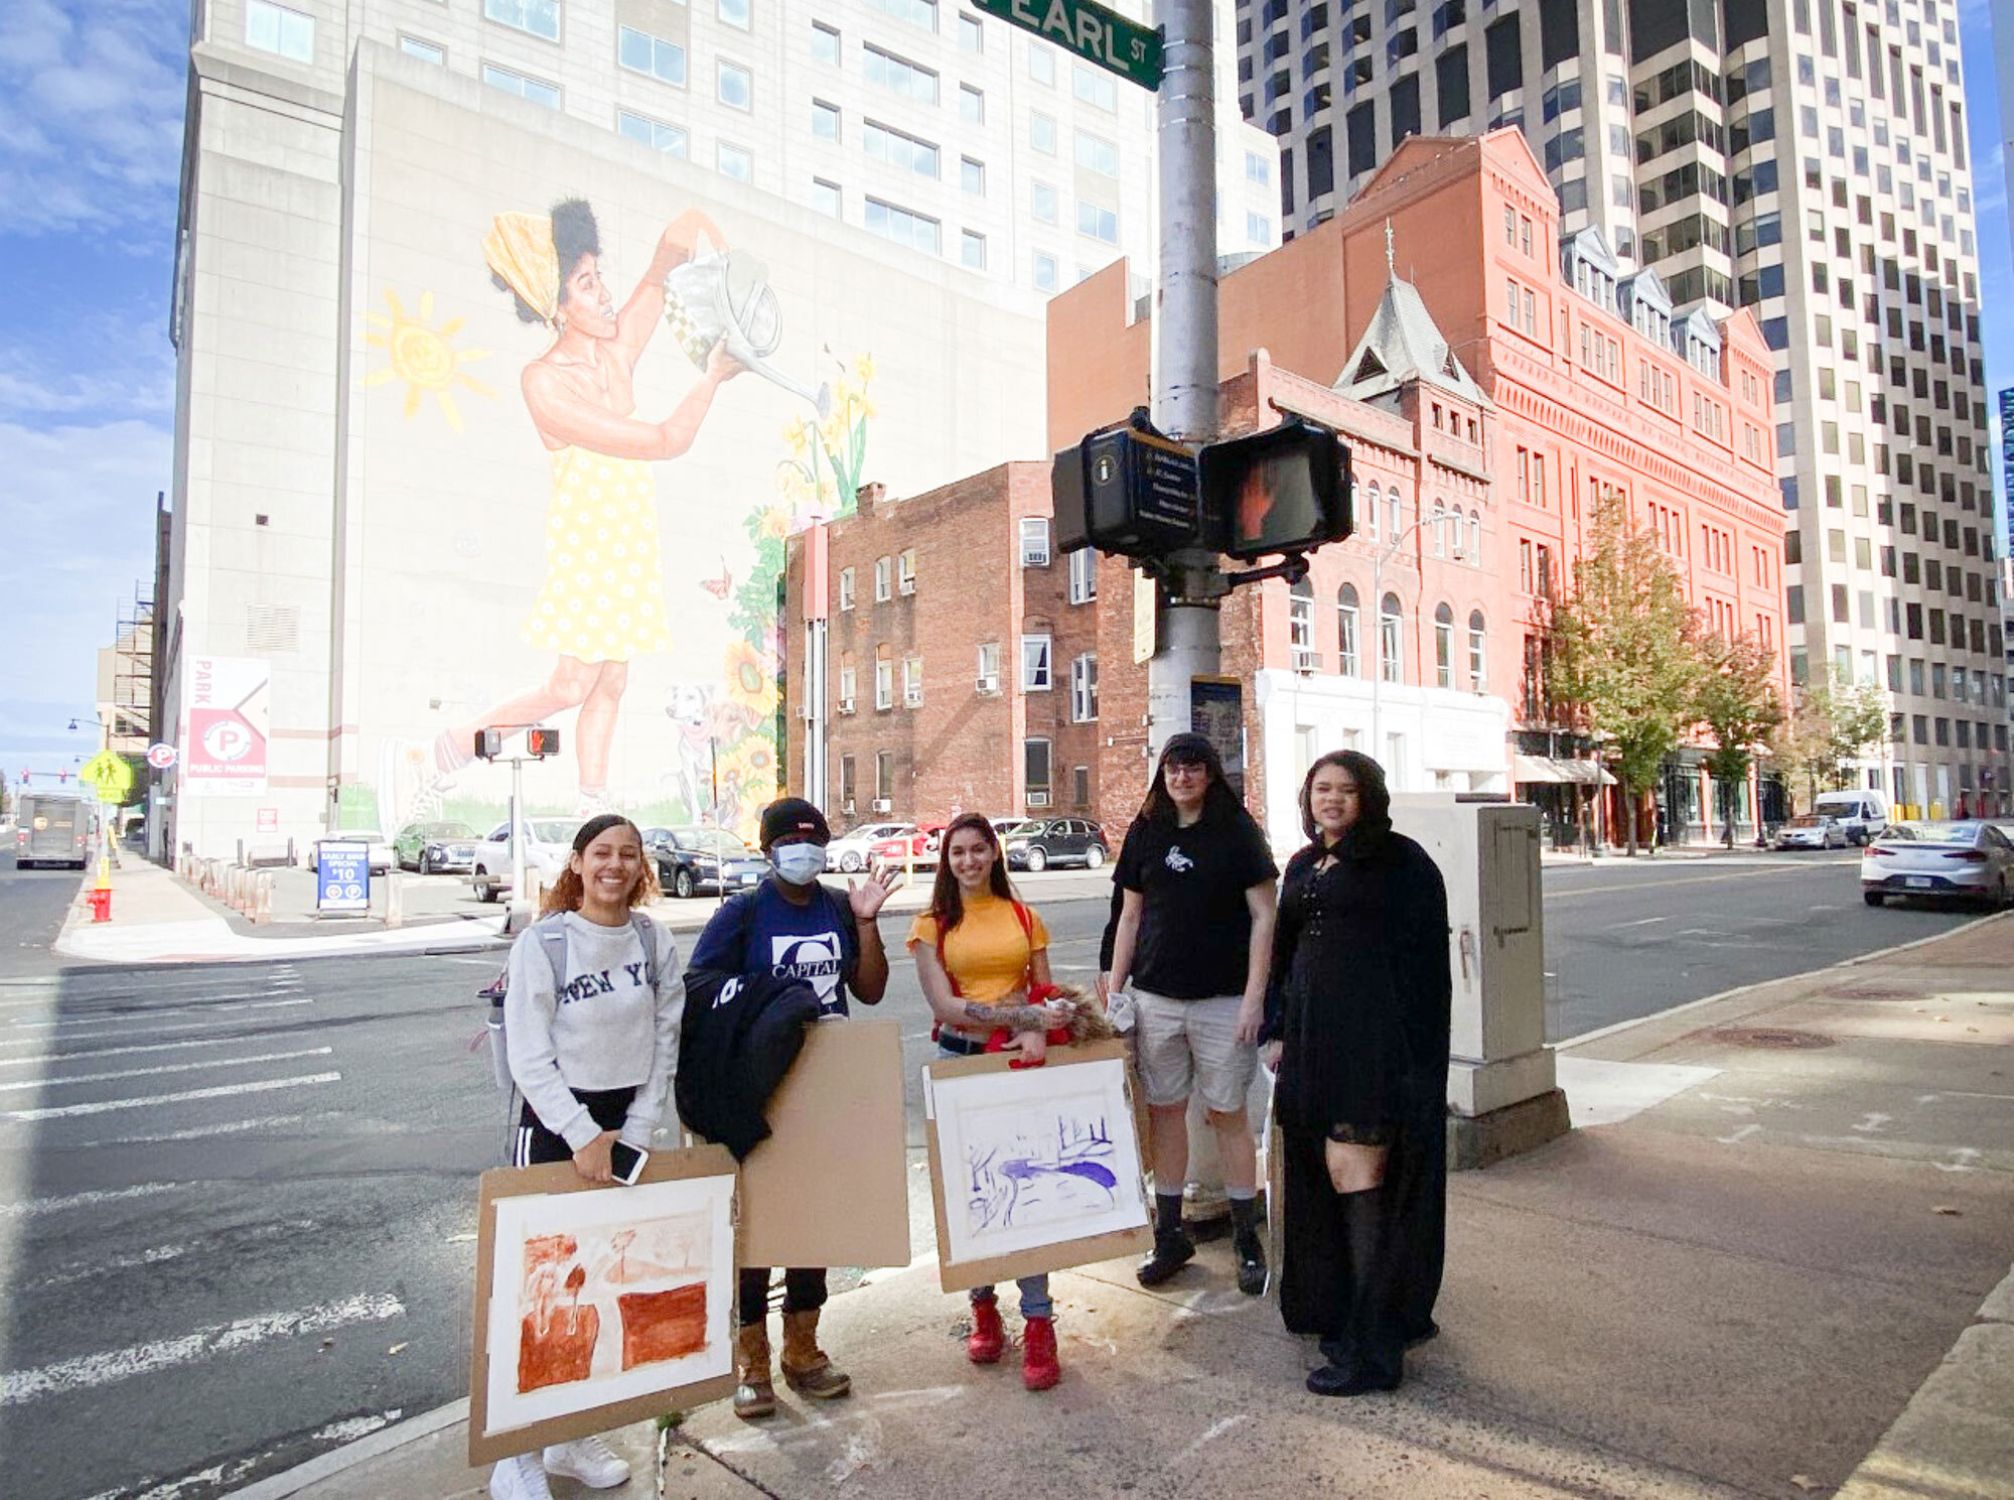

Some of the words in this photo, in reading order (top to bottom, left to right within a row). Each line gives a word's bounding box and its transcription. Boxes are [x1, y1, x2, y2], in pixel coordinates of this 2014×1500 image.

[980, 0, 1130, 72] EARL
[1130, 37, 1147, 64] ST
[195, 660, 213, 704] PARK
[219, 730, 240, 751] P
[190, 764, 223, 773] PUBLIC
[224, 764, 265, 773] PARKING
[771, 959, 838, 979] CAPITAL
[560, 968, 616, 1004] NEW
